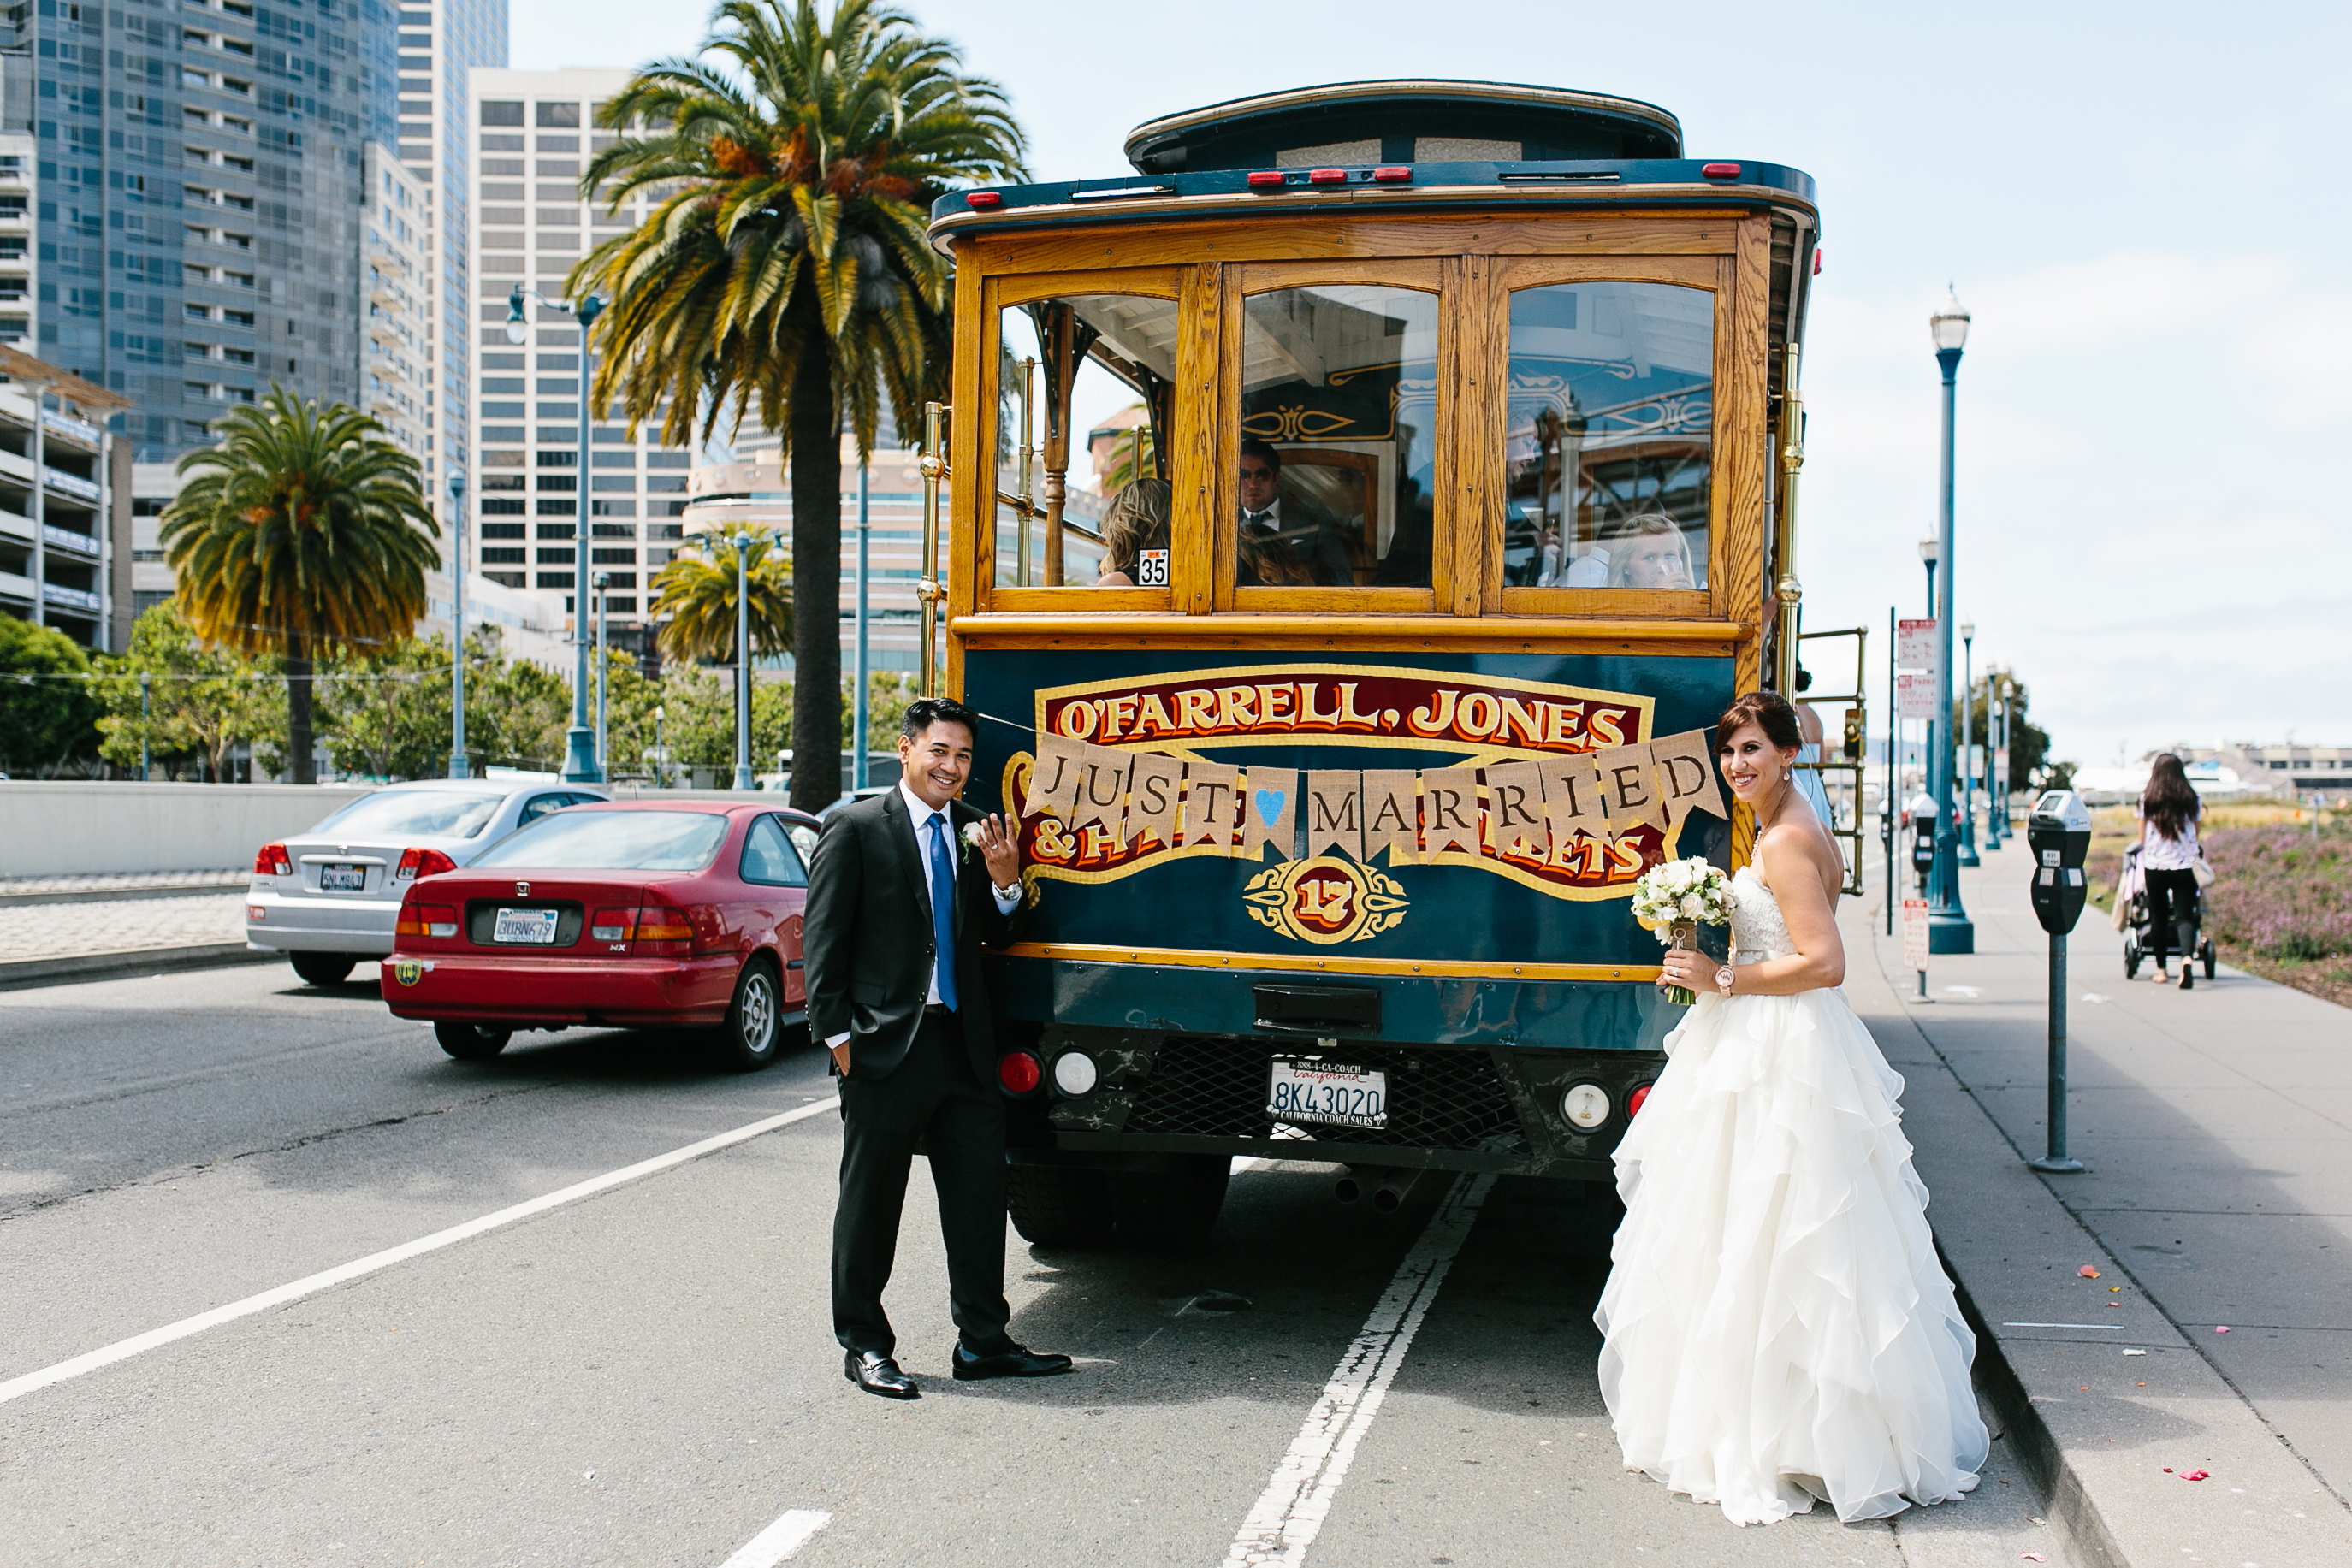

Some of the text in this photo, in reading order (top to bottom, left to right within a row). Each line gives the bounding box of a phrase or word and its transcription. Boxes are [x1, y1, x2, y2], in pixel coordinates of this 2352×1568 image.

[1141, 559, 1164, 583] 35
[1407, 689, 1626, 750] JONES
[1044, 755, 1706, 832] JUST MARRIED
[1296, 879, 1352, 927] 17
[609, 944, 626, 952] HX
[1297, 1061, 1361, 1074] 888-4-CA-COACH
[1275, 1081, 1380, 1116] 8K43020
[1280, 1110, 1373, 1127] CALIFORNIA COACH SALES
